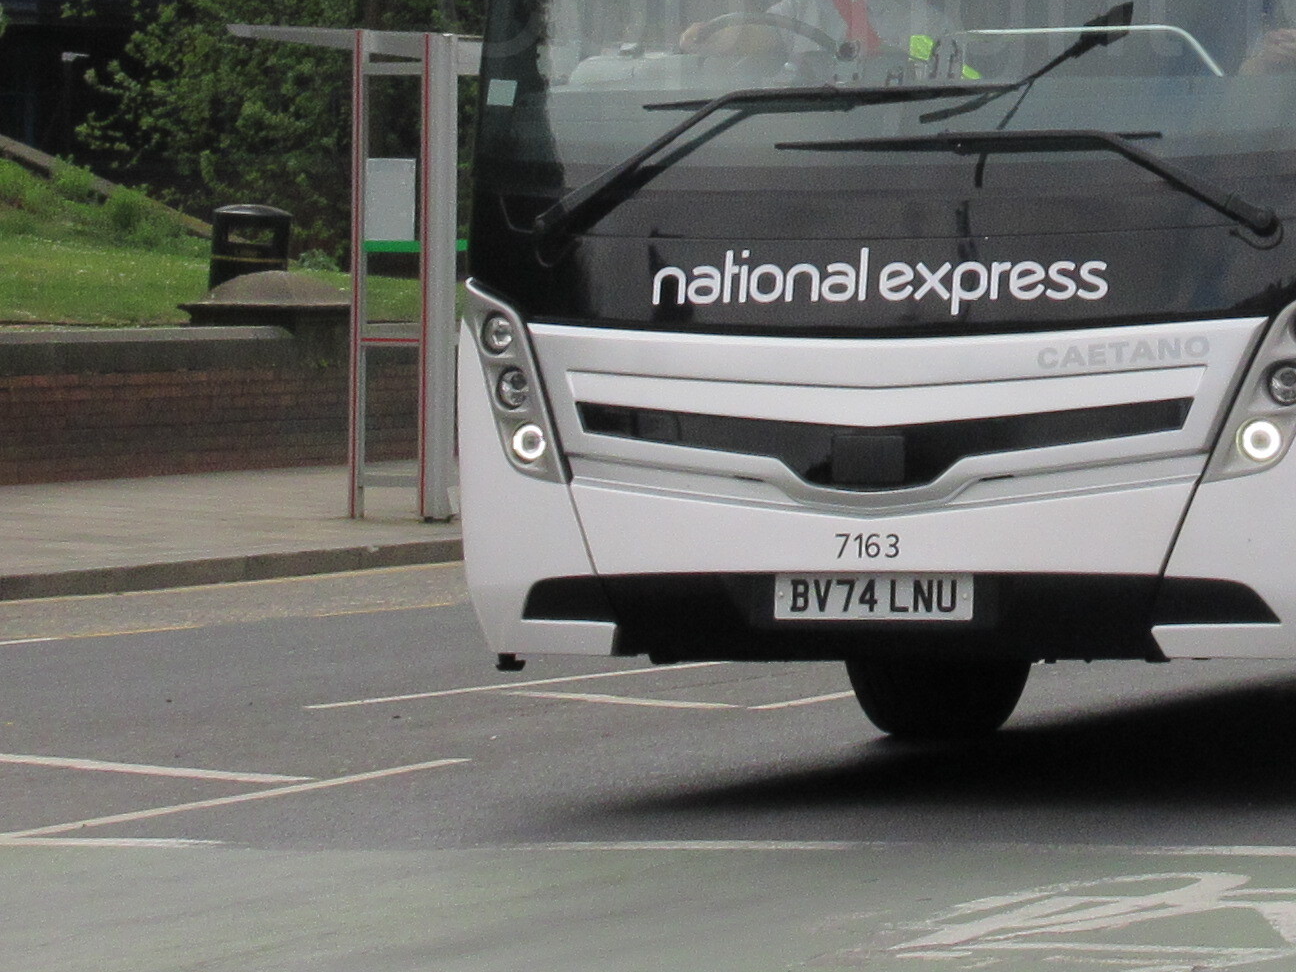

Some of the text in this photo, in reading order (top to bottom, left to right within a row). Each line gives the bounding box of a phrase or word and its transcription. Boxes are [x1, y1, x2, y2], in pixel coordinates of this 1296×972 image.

[652, 247, 1109, 316] national express
[1036, 335, 1211, 370] CAETANO
[834, 532, 901, 560] 7163
[790, 578, 958, 613] BV74 LNU
